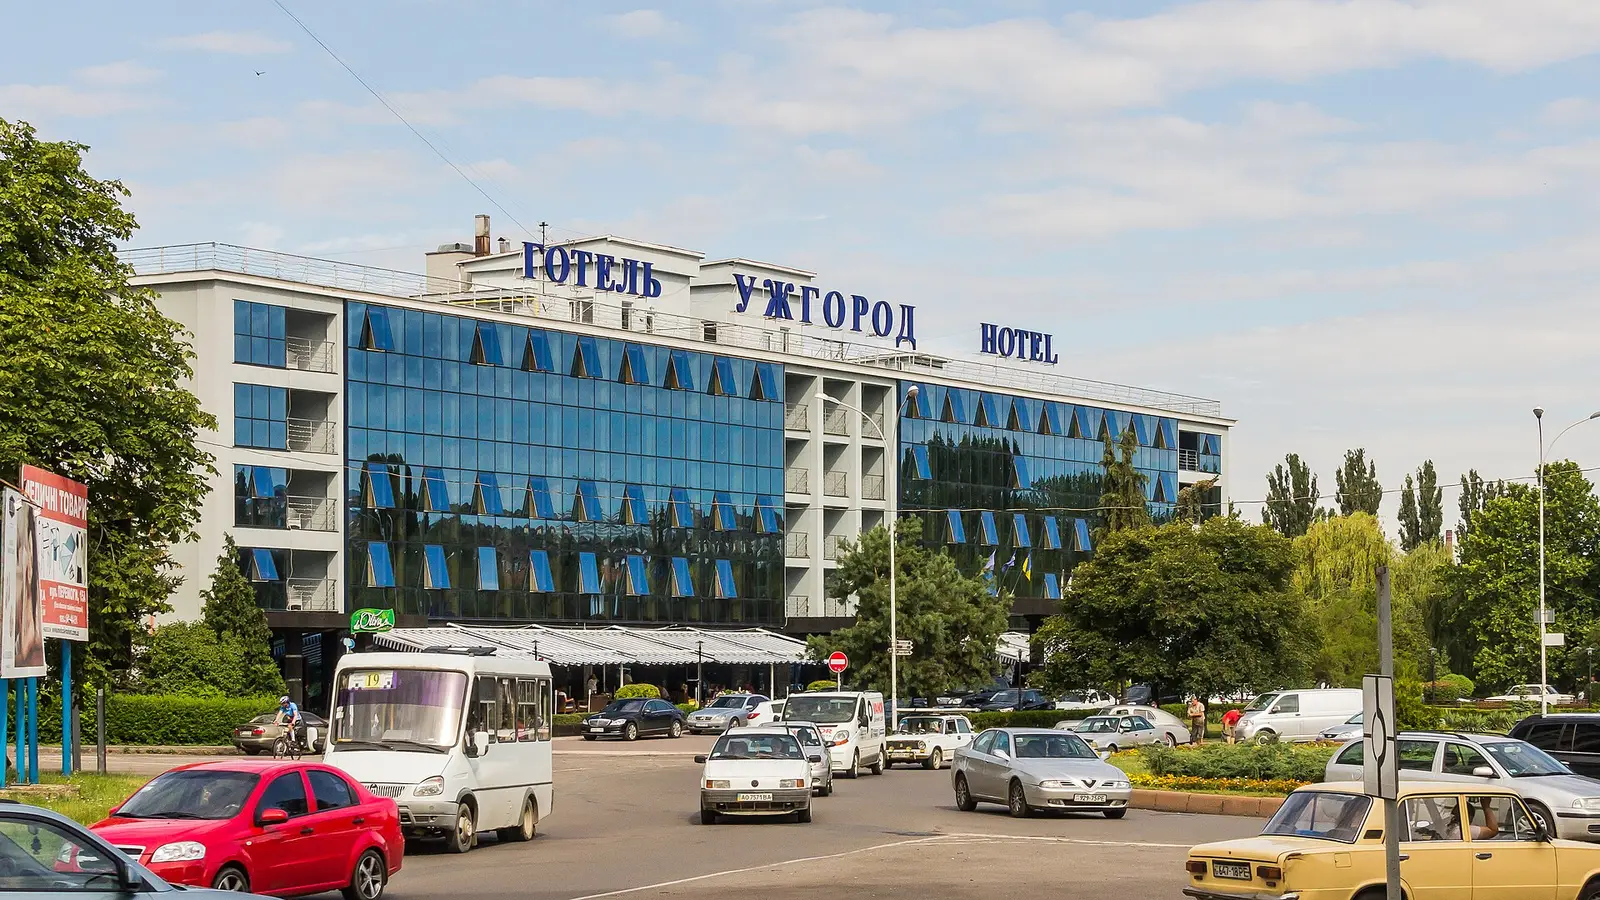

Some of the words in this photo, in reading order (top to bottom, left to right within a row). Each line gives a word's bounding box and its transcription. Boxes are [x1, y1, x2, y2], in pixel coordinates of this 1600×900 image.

[521, 241, 662, 298] ГОТЕЛЬ
[732, 273, 917, 351] УЖГОРОД
[980, 322, 1058, 364] HOTEL
[59, 489, 87, 520] ТОВАРИ
[367, 673, 379, 686] 19
